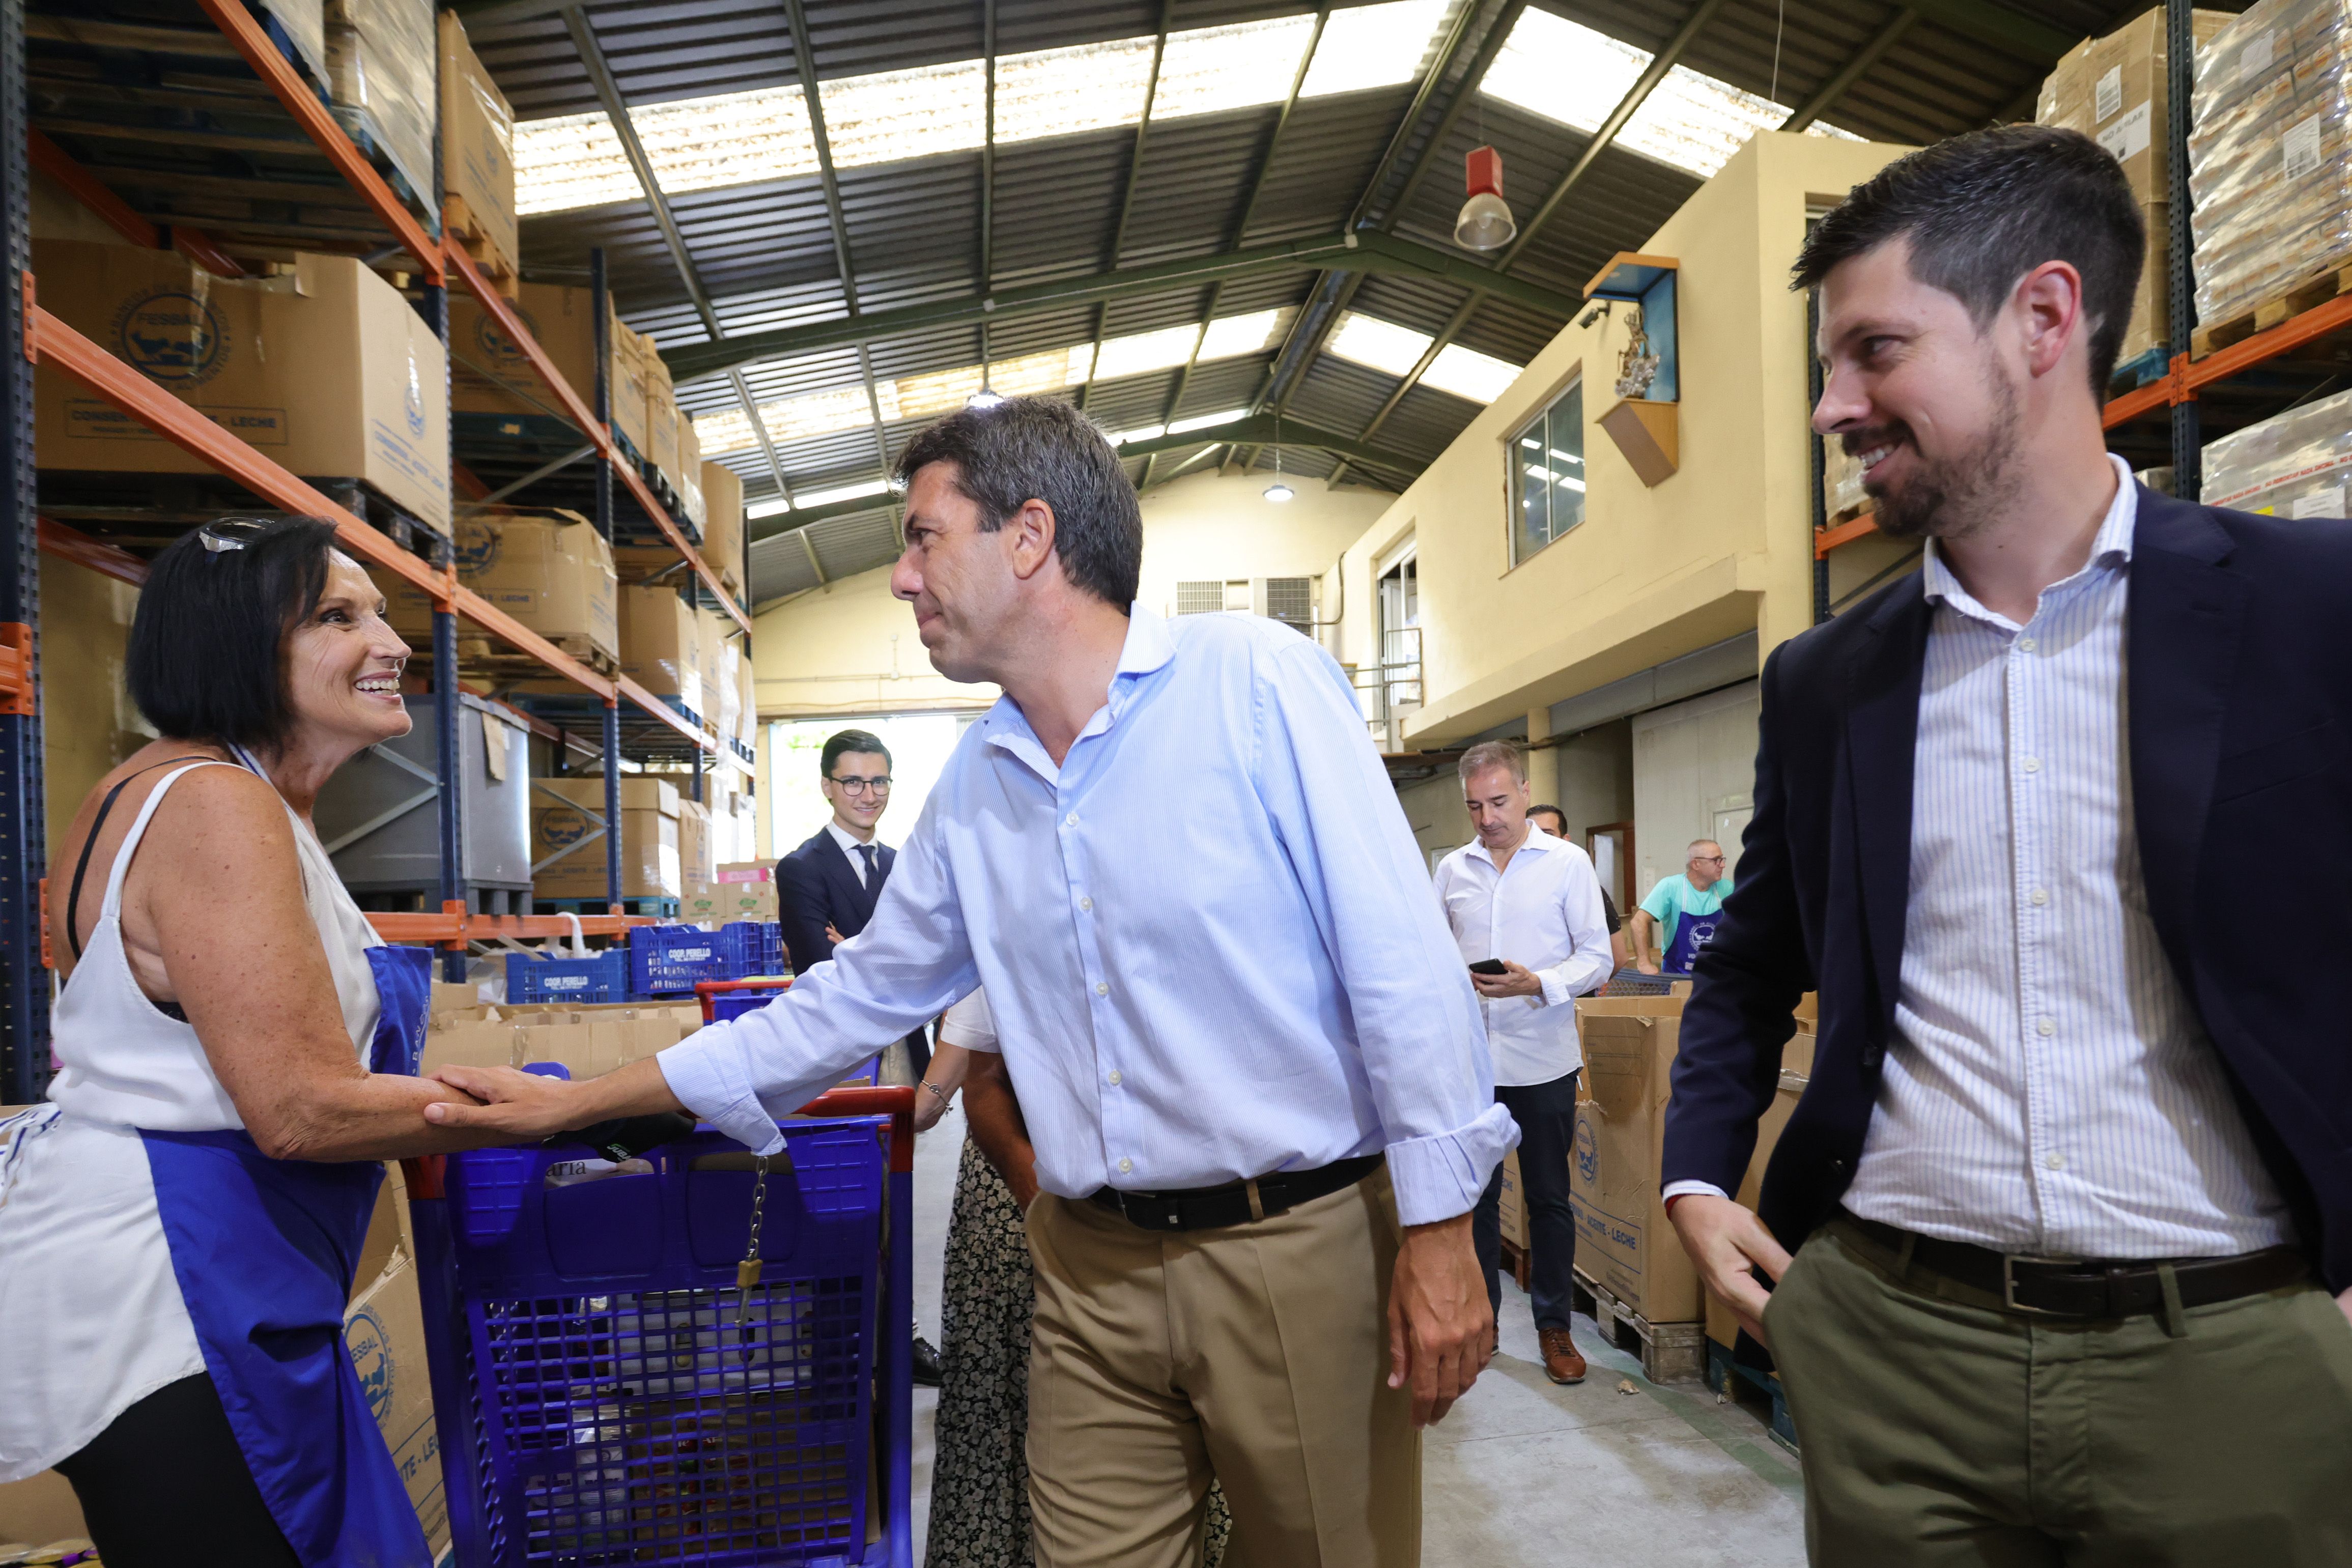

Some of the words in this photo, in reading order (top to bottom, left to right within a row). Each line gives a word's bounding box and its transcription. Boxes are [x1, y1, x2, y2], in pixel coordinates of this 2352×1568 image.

[231, 416, 277, 429] LECHE
[1612, 1227, 1636, 1250] LECHE
[350, 1334, 379, 1364] ESBAL
